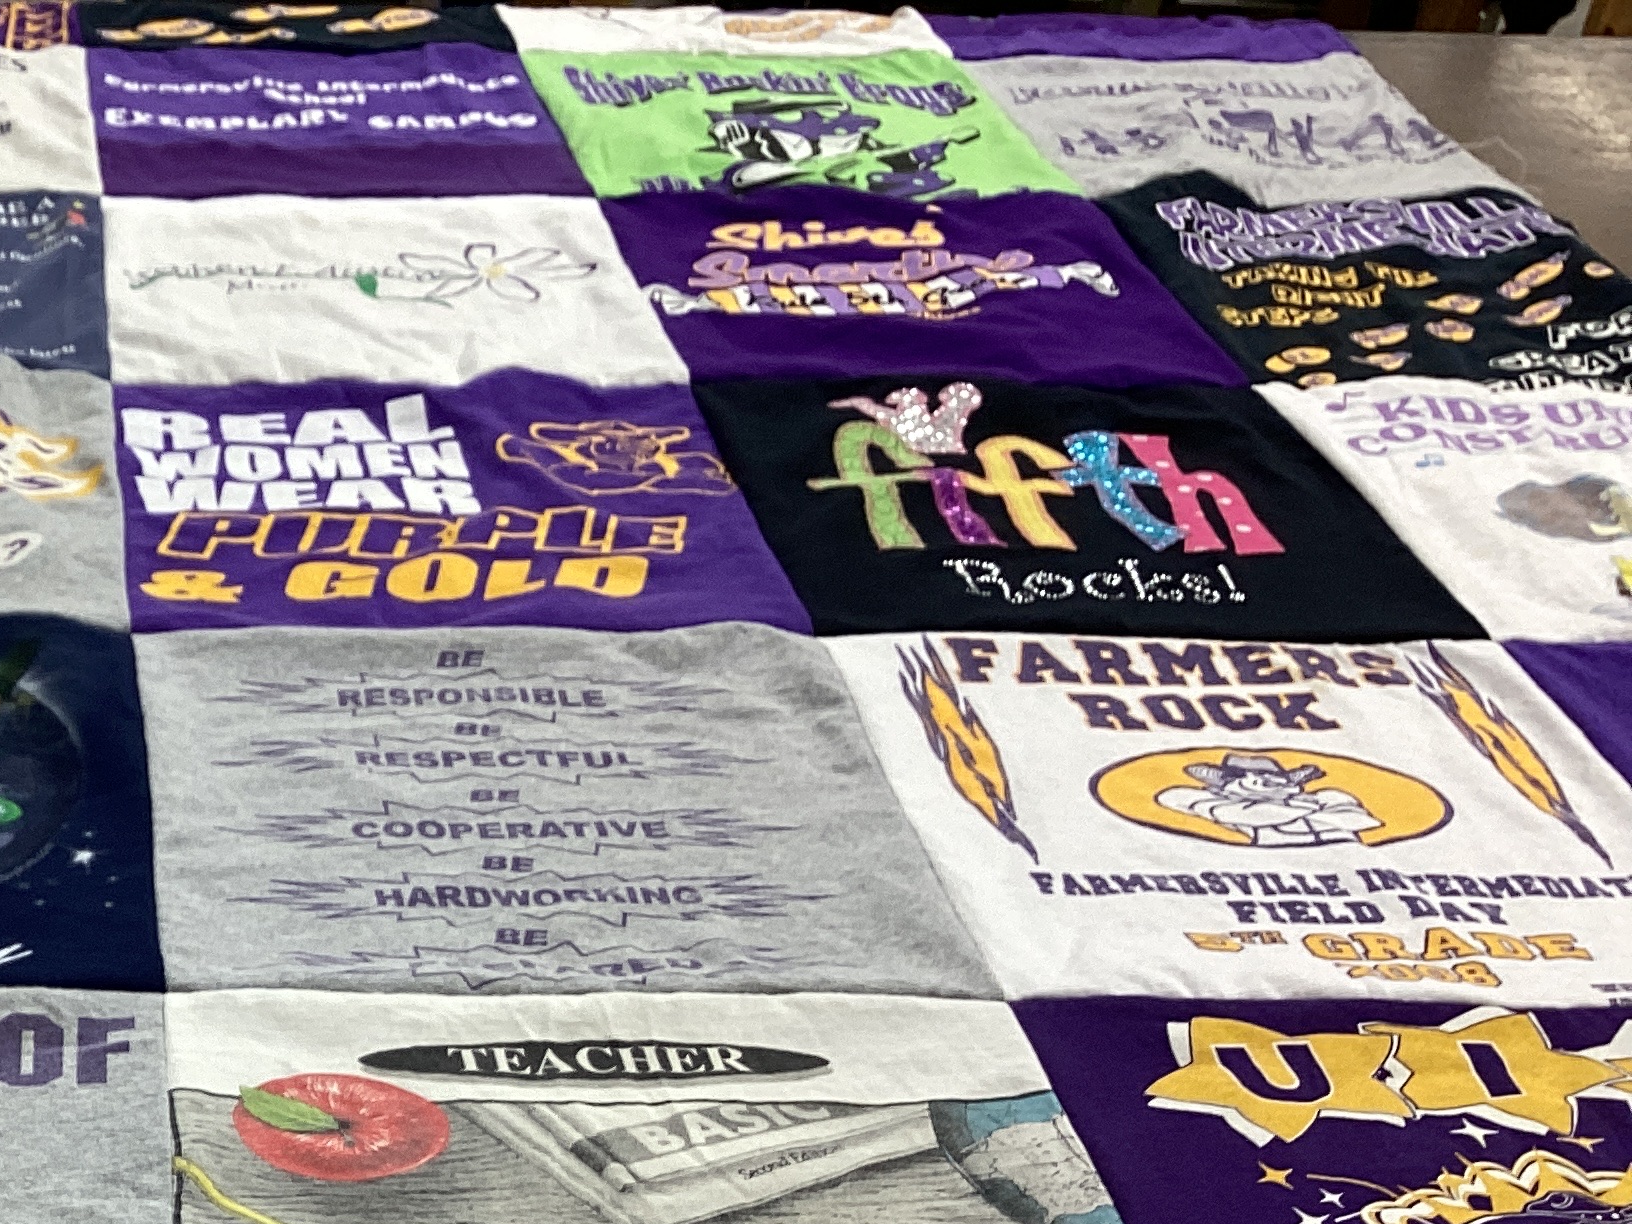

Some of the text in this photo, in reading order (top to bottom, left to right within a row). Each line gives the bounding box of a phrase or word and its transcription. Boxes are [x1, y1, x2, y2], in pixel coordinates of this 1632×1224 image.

[121, 393, 456, 450] REAL
[1374, 394, 1531, 425] KIDS
[130, 442, 471, 482] WOMEN
[135, 474, 482, 515] WEAR
[806, 420, 1286, 555] fifth
[158, 504, 689, 559] PURPLE
[140, 551, 649, 603] & GOLD
[942, 557, 1247, 603] Rocks!
[436, 648, 487, 669] BE
[943, 636, 1412, 687] FARMERS
[336, 686, 608, 708] RESPONSIBLE
[1067, 690, 1342, 732] ROCK
[354, 748, 647, 769] RESPECTFUL
[351, 819, 671, 841] COOPERATIVE
[481, 854, 535, 873] BE
[373, 886, 704, 909] HARDWORKING
[1029, 870, 1351, 899] FARMERSVILLE
[1227, 896, 1509, 925] FIELD DAY
[494, 927, 549, 947] BE
[1301, 926, 1595, 962] GRADE
[446, 1044, 751, 1076] TEACHER
[626, 1101, 832, 1156] BASIC
